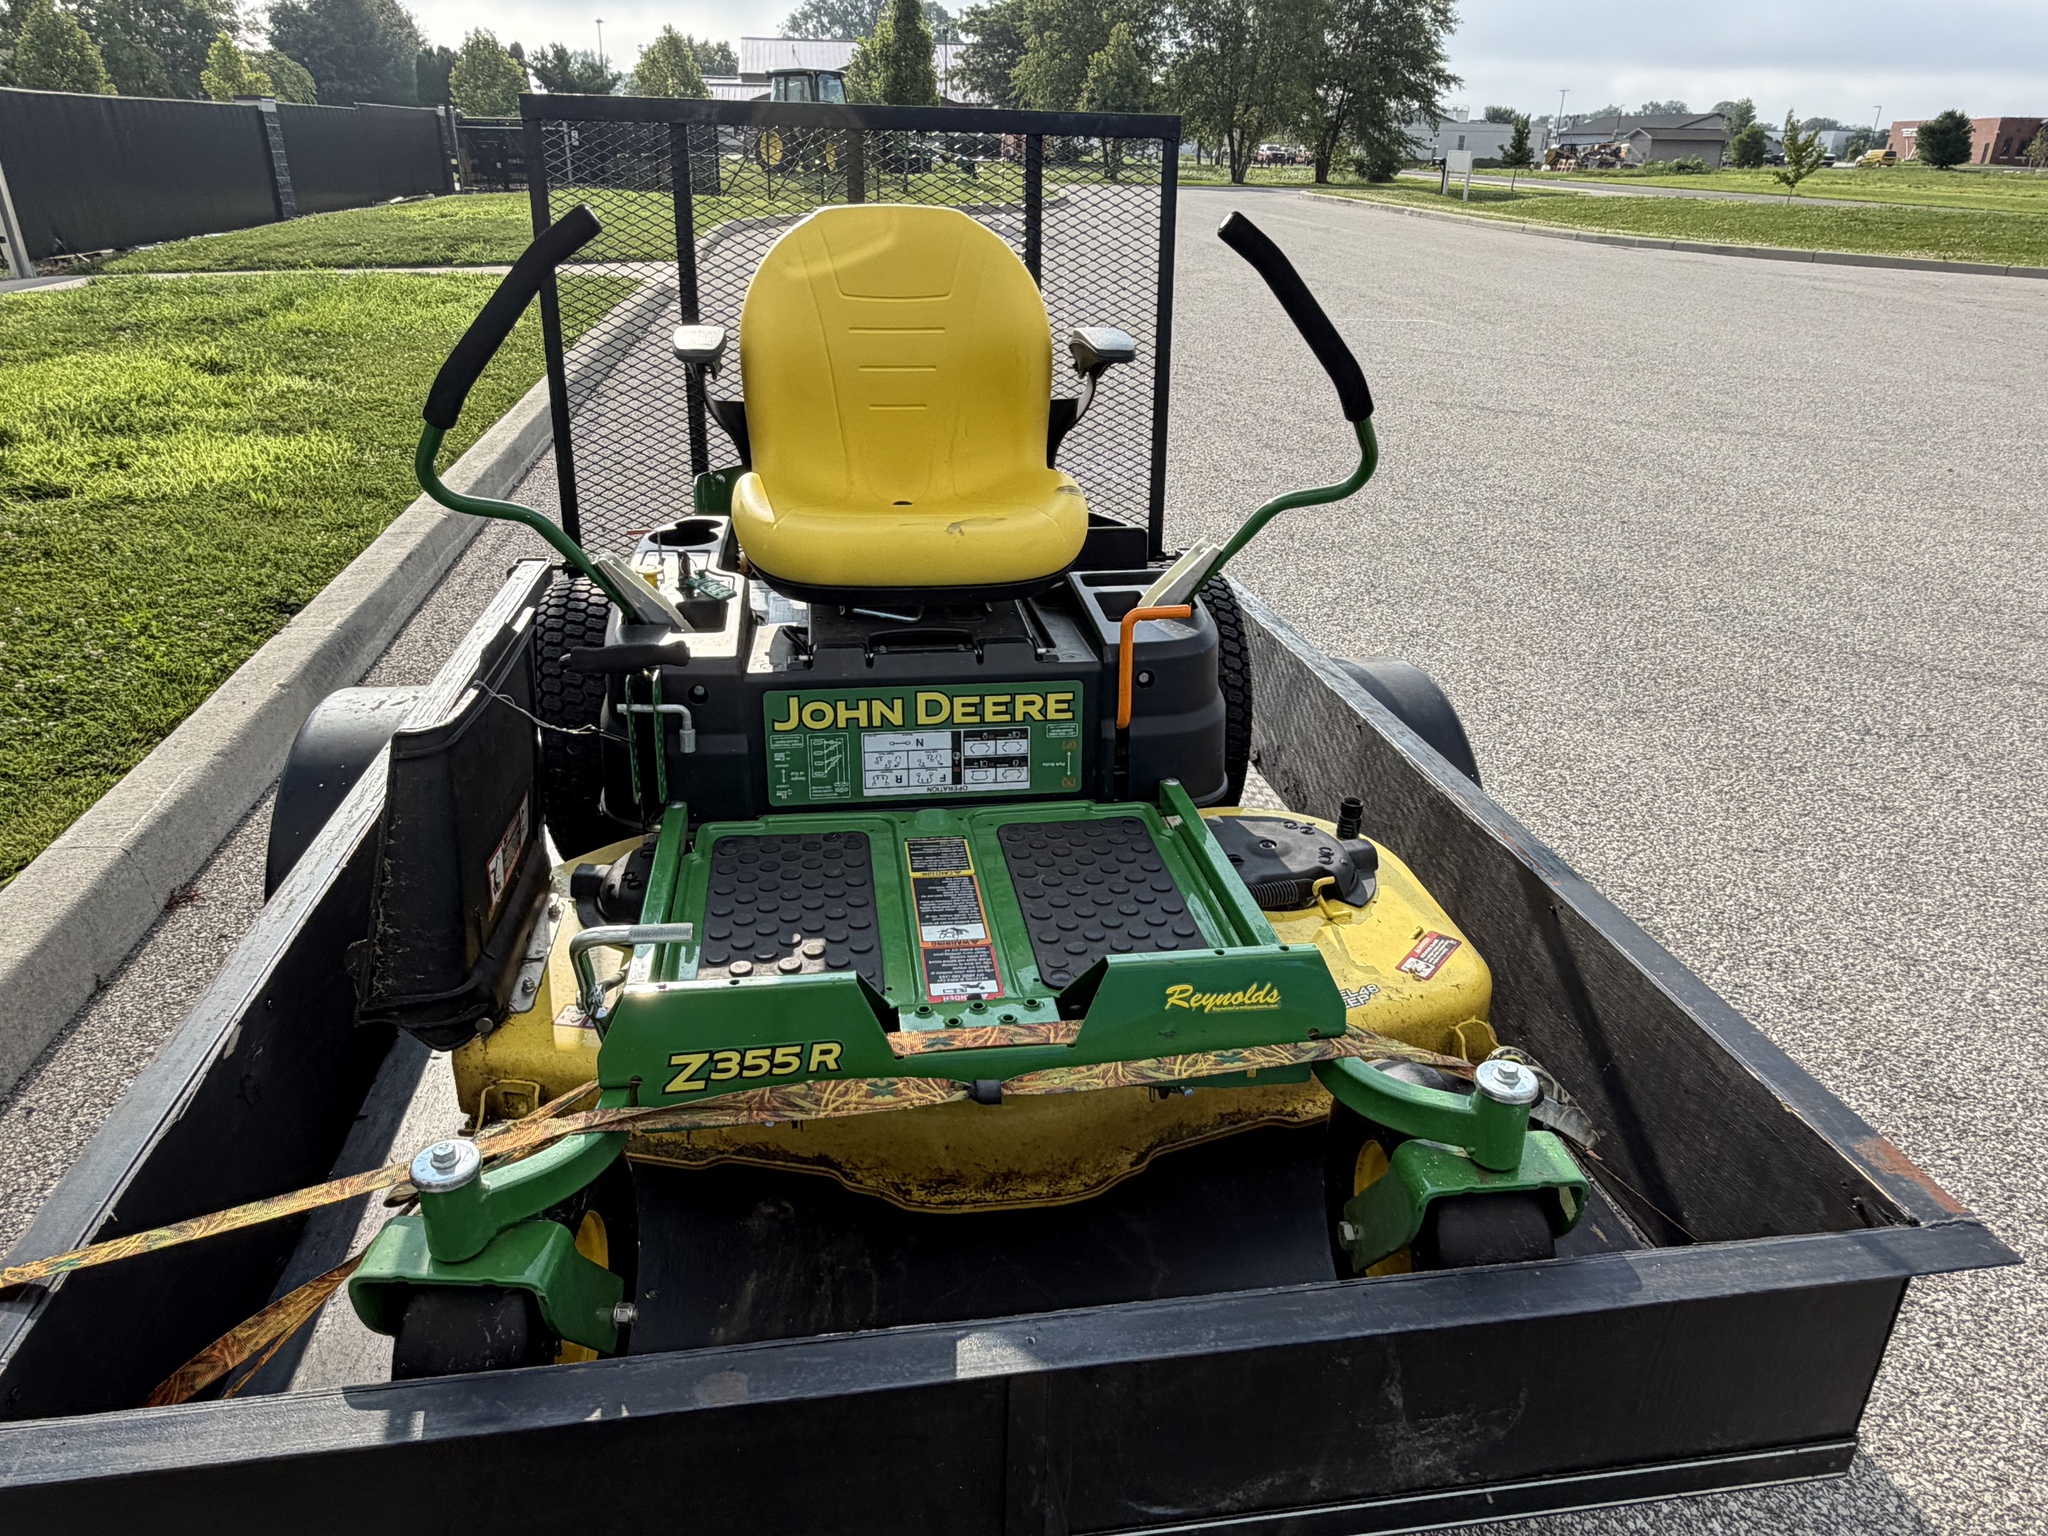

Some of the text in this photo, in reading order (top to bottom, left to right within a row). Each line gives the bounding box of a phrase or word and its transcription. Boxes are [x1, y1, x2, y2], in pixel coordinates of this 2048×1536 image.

[772, 690, 1075, 732] JOHN DEERE
[926, 785, 969, 793] OPERATION
[1165, 982, 1281, 1013] Reynolds
